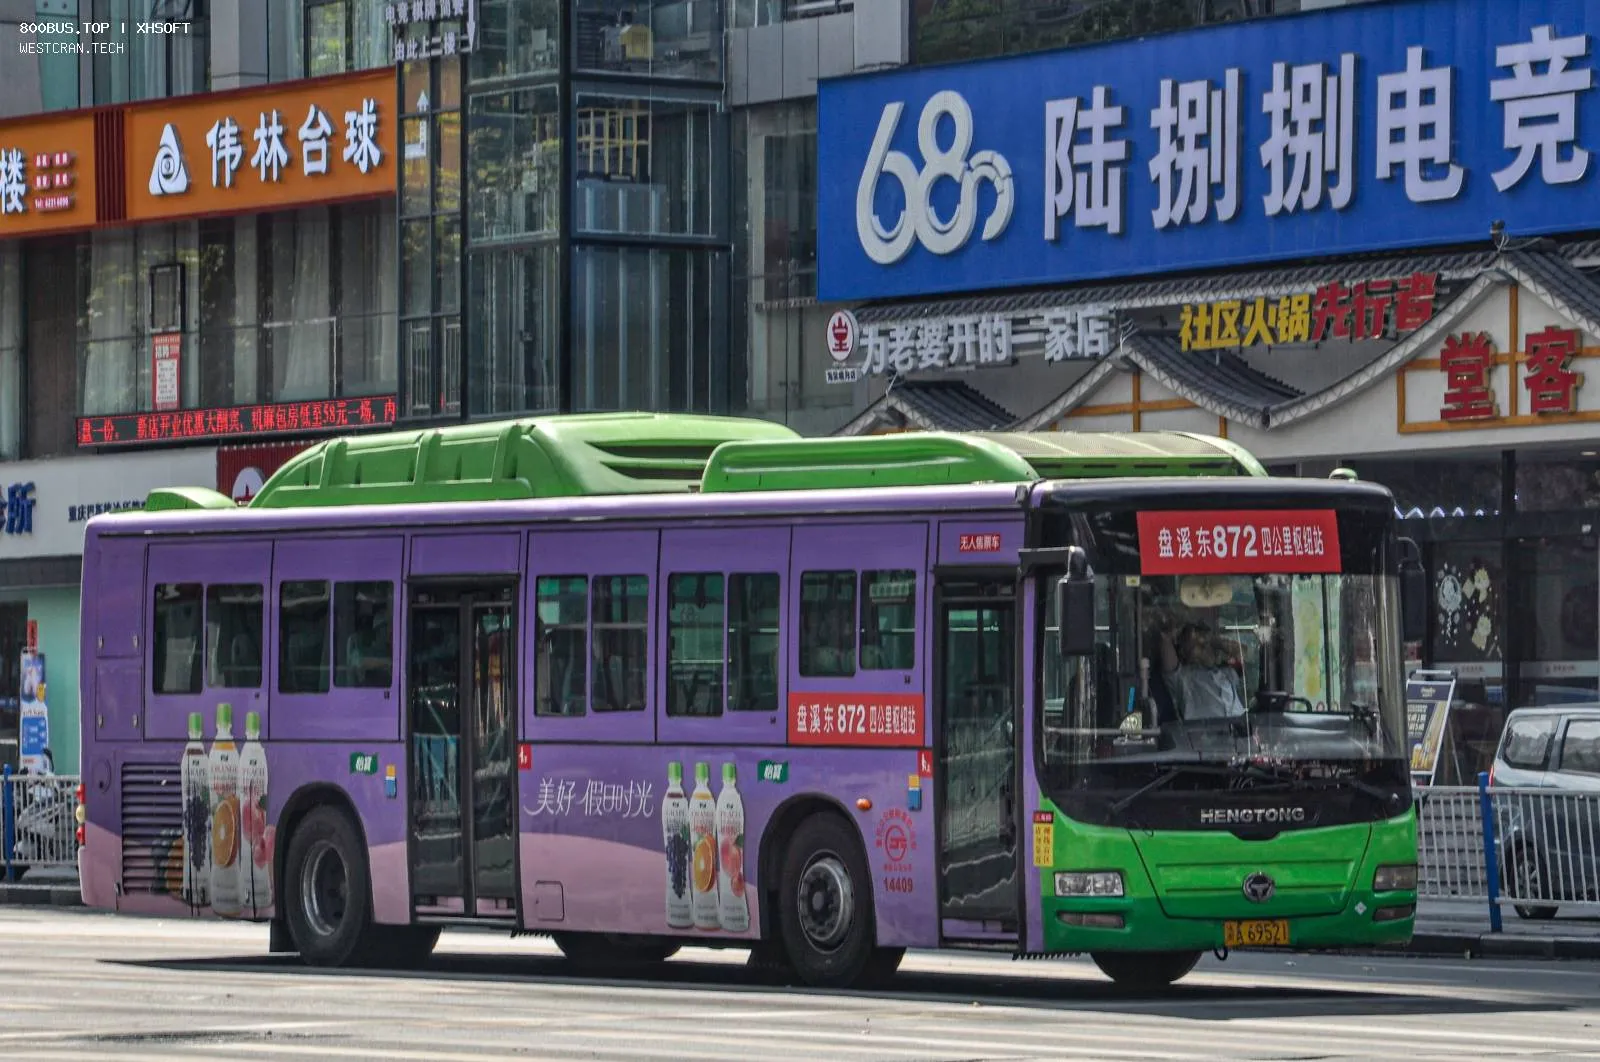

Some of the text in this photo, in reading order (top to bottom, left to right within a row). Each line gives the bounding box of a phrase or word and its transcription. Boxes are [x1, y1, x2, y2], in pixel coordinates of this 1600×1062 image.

[206, 98, 383, 189] 伟林台球
[1044, 24, 1596, 241] 陆捌捌电竞
[0, 147, 26, 215] 楼
[860, 307, 1110, 375] 为老婆开的一家店
[1158, 524, 1325, 559] 盘溪东 872 四公里枢纽站
[797, 703, 916, 735] 盘溪东 872 四公里枢纽站
[534, 777, 655, 819] 美好假日时光
[1200, 807, 1305, 824] HENGTONG
[883, 877, 914, 893] 14409
